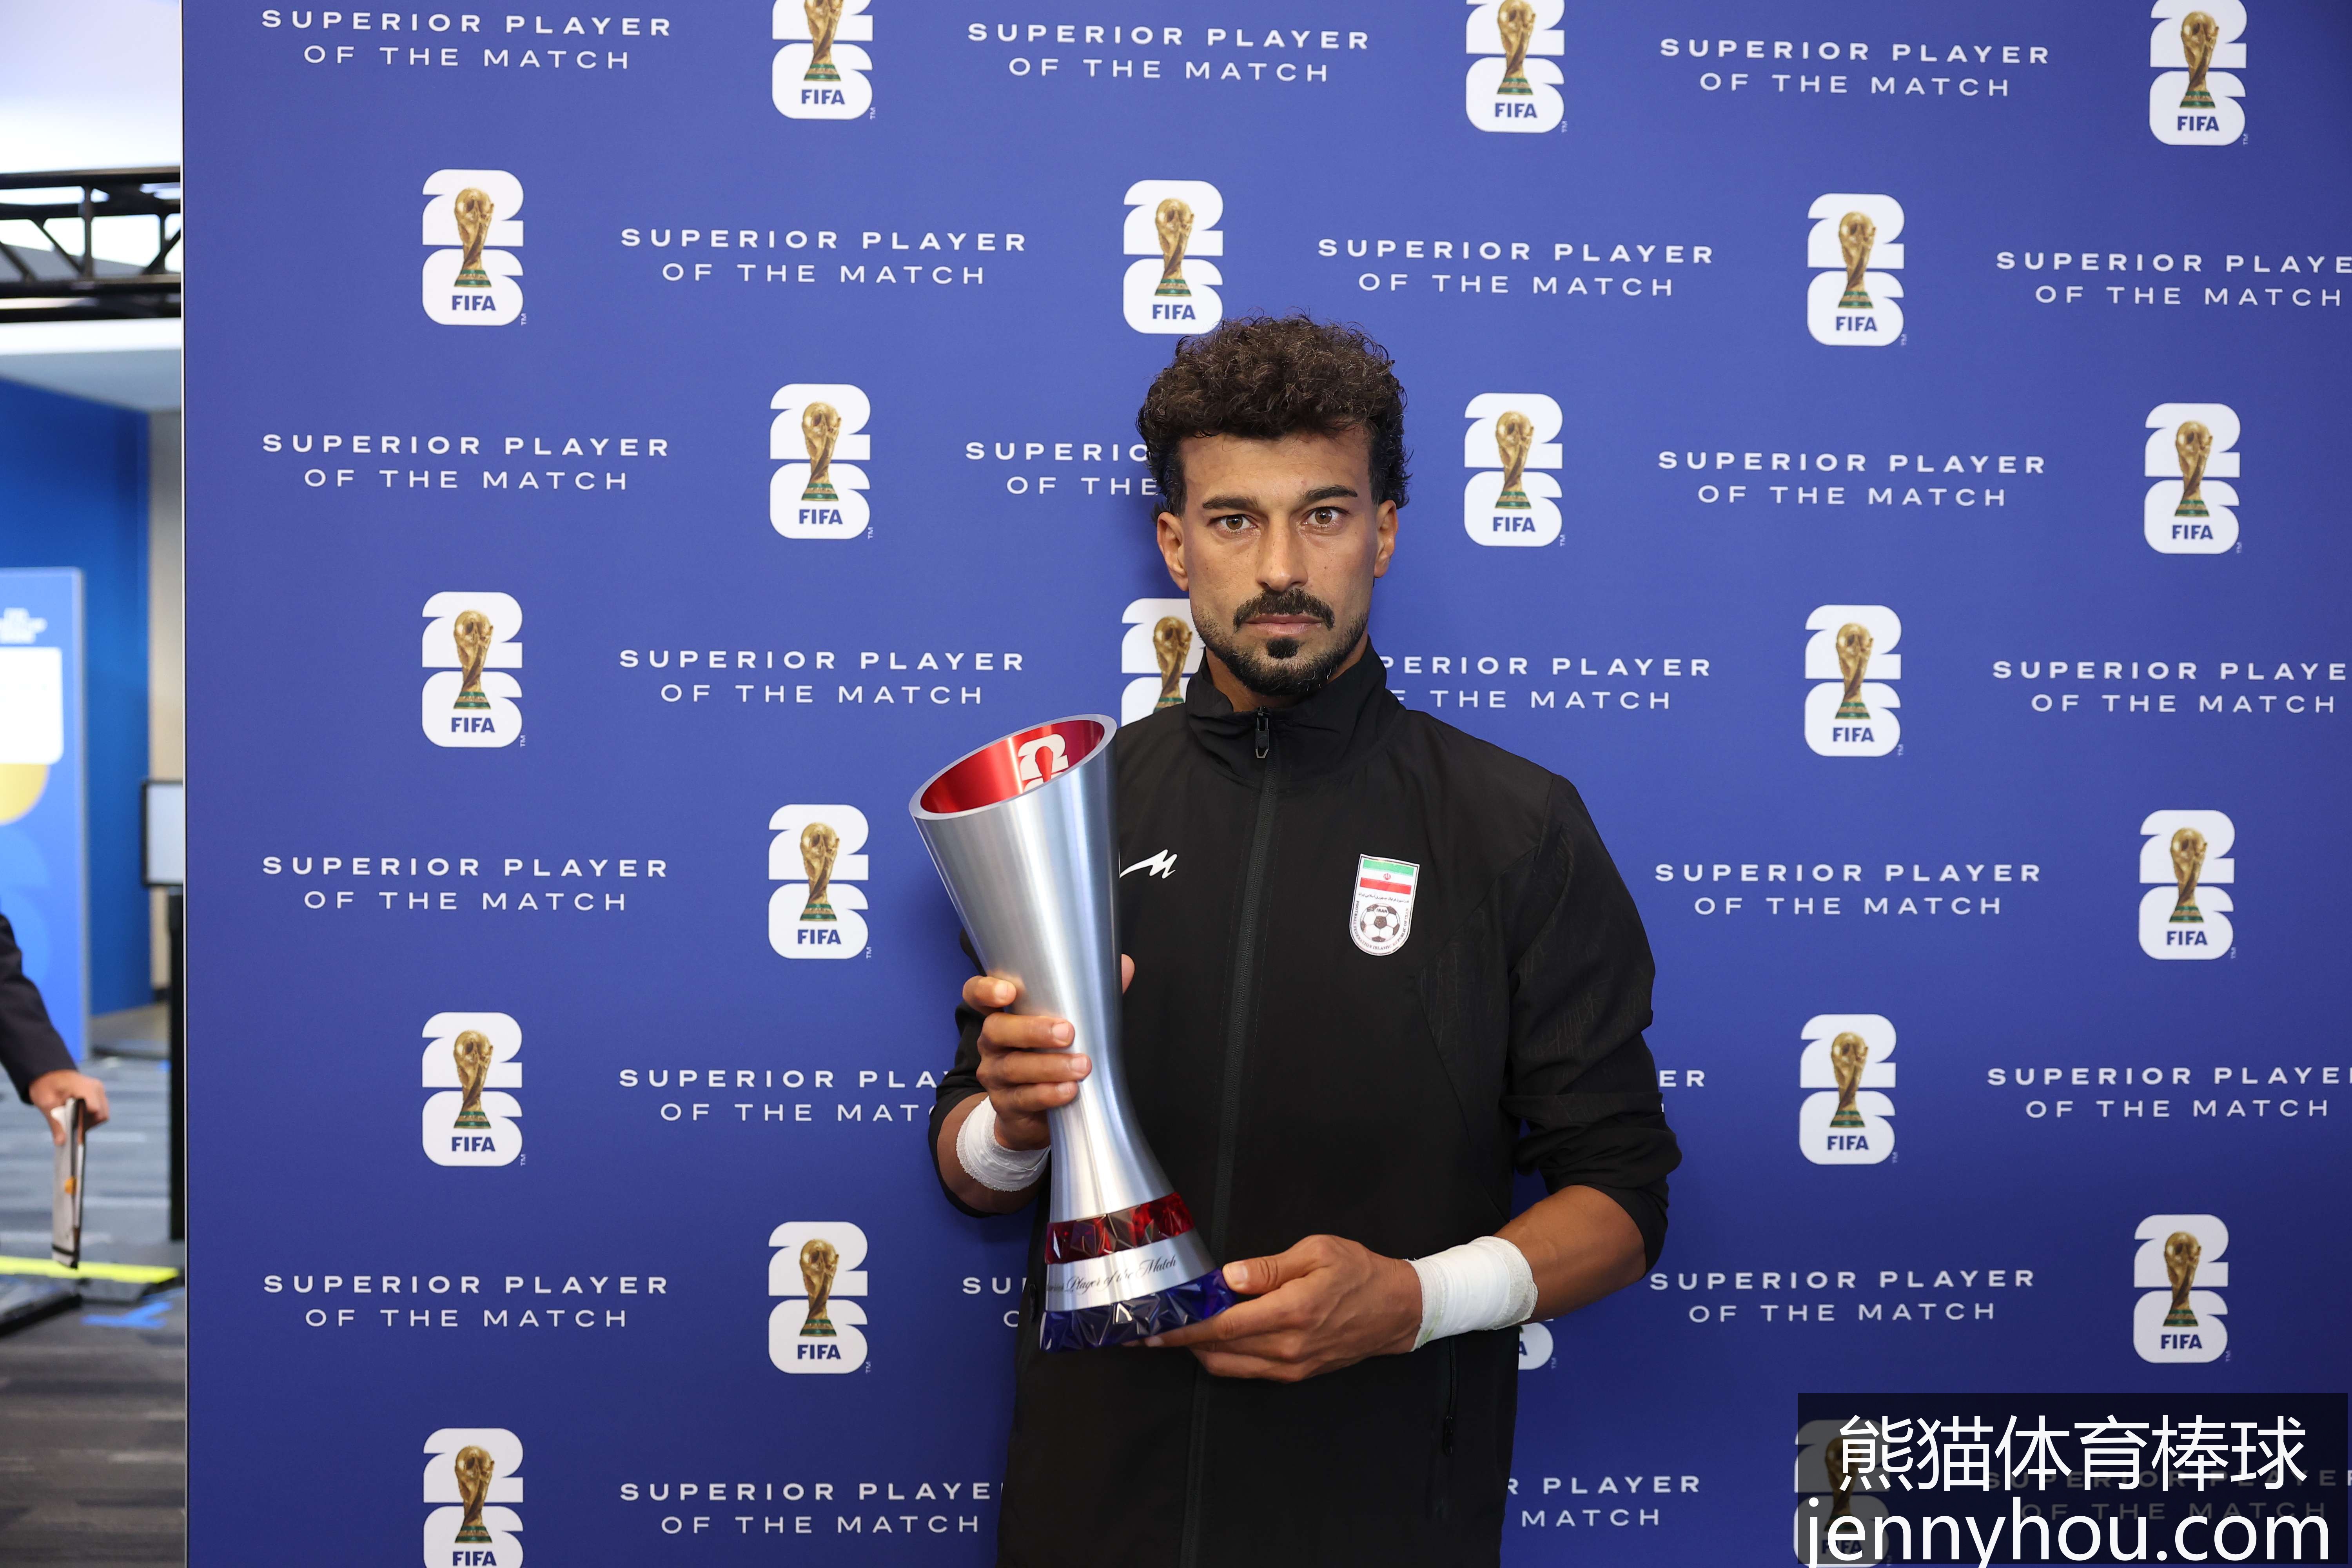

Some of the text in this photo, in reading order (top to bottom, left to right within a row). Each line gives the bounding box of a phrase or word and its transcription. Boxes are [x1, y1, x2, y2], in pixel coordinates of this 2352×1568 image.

[262, 10, 669, 36] SUPERIOR PLAYER
[968, 24, 1367, 49] SUPERIOR PLAYER
[304, 45, 627, 69] OF THE MATCH
[1661, 39, 2048, 64] SUPERIOR PLAYER
[1009, 58, 1326, 82] OF THE MATCH
[1700, 73, 2007, 96] OF THE MATCH
[802, 90, 844, 104] FIFA
[1495, 103, 1537, 118] FIFA
[2178, 116, 2219, 131] FIFA
[621, 229, 1024, 251] SUPERIOR PLAYER
[1319, 239, 1712, 263] SUPERIOR PLAYER
[1997, 252, 2352, 273] SUPERIOR PLAYE
[662, 263, 982, 284] OF THE MATCH
[1359, 273, 1671, 296] OF THE MATCH
[452, 296, 495, 310] FIFA
[2036, 286, 2340, 306] OF THE MATCH
[1153, 305, 1195, 319] FIFA
[1837, 317, 1877, 331] FIFA
[263, 434, 667, 456] SUPERIOR PLAYER
[966, 442, 1148, 461] SUPERIO
[1659, 452, 2043, 473] SUPERIOR PLAYER
[305, 469, 625, 490] OF THE MATCH
[1007, 477, 1158, 495] OF THE
[1699, 485, 2004, 506] OF THE MATCH
[800, 510, 842, 524] FIFA
[1494, 517, 1535, 532] FIFA
[2173, 525, 2213, 539] FIFA
[620, 650, 1022, 670] SUPERIOR PLAYER
[1379, 656, 1709, 676] PERIOR PLAYER
[1993, 661, 2346, 680] SUPERIOR PLAYE
[661, 684, 980, 704] OF THE MATCH
[1430, 690, 1668, 709] THE MATCH
[2032, 694, 2333, 713] OF THE MATCH
[452, 718, 495, 732] FIFA
[1833, 728, 1873, 742] FIFA
[263, 857, 666, 877] SUPERIOR PLAYER
[1655, 864, 2039, 881] SUPERIOR PLAYER
[305, 891, 624, 911] OF THE MATCH
[1695, 897, 1999, 915] OF THE MATCH
[798, 929, 841, 944] FIFA
[2167, 931, 2207, 945] FIFA
[620, 1069, 949, 1088] SUPERIOR PLA
[1987, 1067, 2352, 1085] SUPERIOR PLAYE
[661, 1103, 935, 1122] OF THE MAT
[2026, 1100, 2327, 1118] OF THE MATCH
[452, 1137, 495, 1151] FIFA
[1828, 1136, 1869, 1150] FIFA
[1065, 1276, 1100, 1295] Player
[1136, 1255, 1176, 1279] Match
[1650, 1270, 2033, 1290] SUPERIOR PLAYER
[264, 1276, 666, 1294] SUPERIOR PLAYER
[306, 1309, 625, 1327] OF THE MATCH
[1689, 1303, 1993, 1323] OF THE MATCH
[2161, 1334, 2202, 1349] FIFA
[798, 1345, 840, 1359] FIFA
[621, 1483, 1003, 1501] SUPERIOR PLAYE
[1544, 1476, 1699, 1494] PLAYER
[1522, 1509, 1658, 1527] MATCH
[2022, 1502, 2324, 1520] OF THE MATCH
[662, 1516, 977, 1534] OF THE MATCH
[453, 1552, 496, 1566] FIFA
